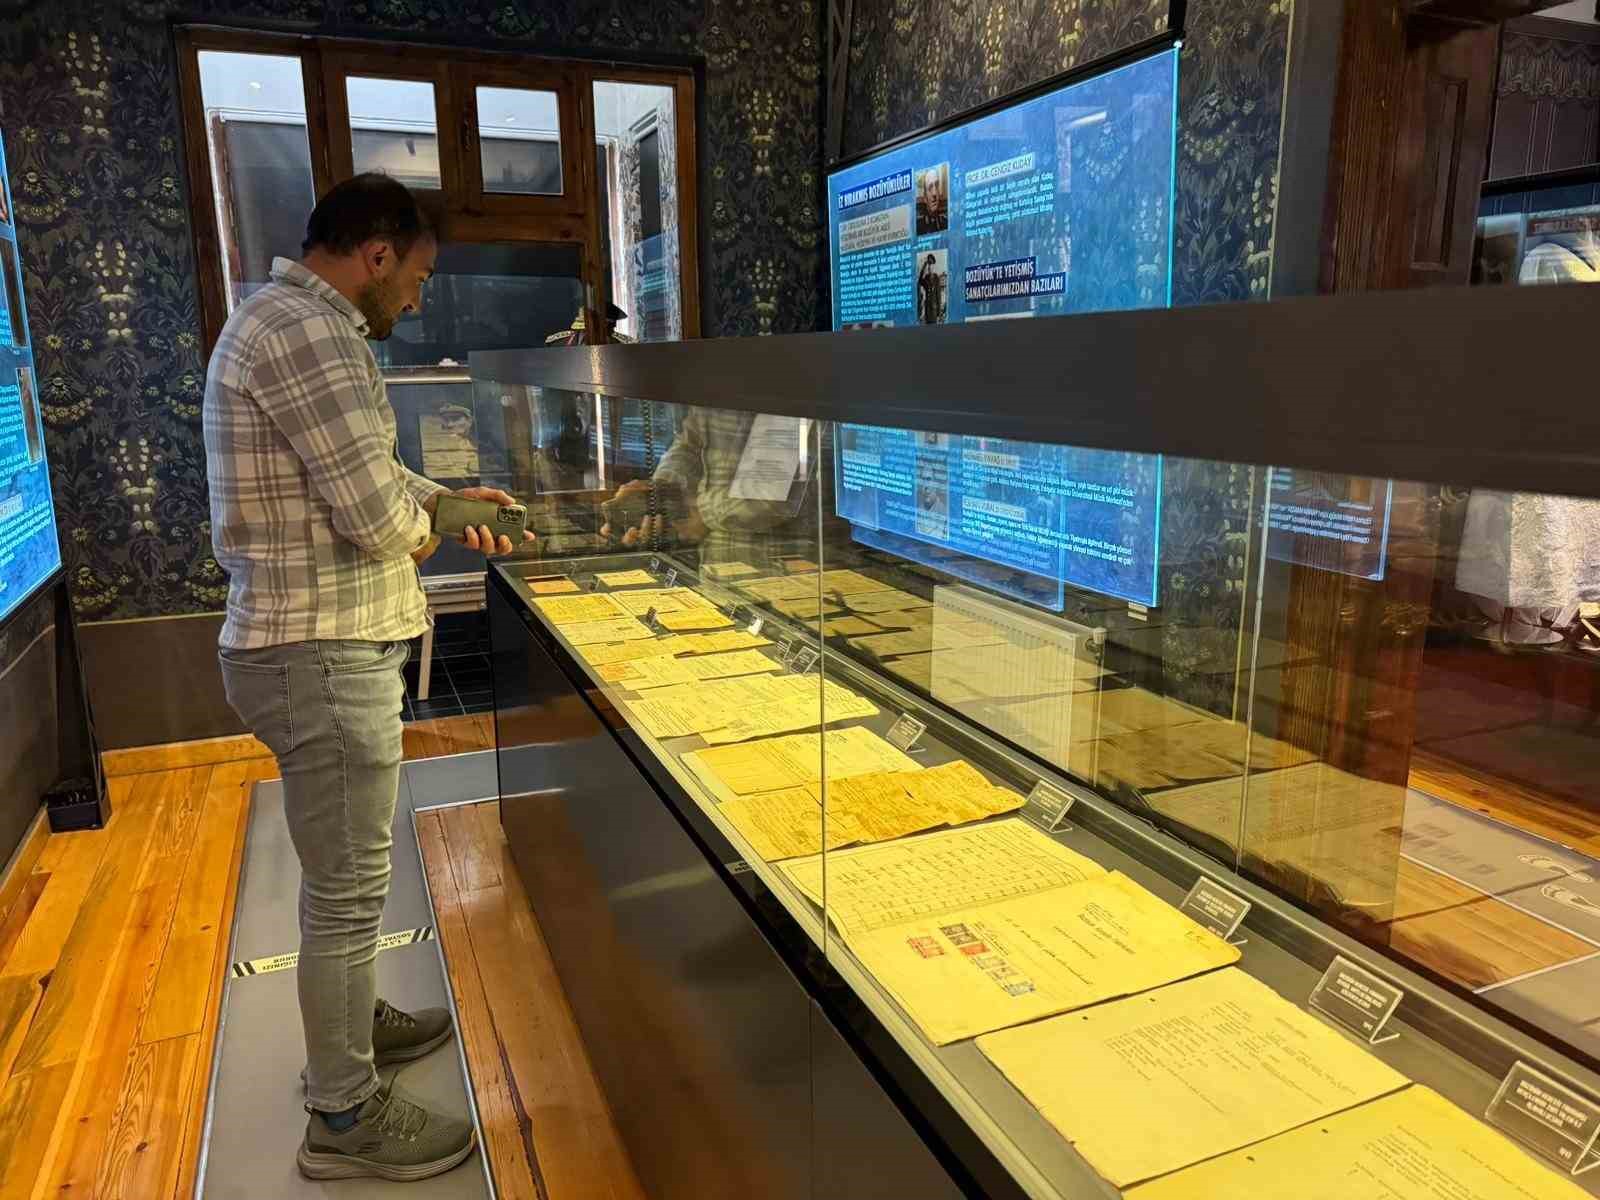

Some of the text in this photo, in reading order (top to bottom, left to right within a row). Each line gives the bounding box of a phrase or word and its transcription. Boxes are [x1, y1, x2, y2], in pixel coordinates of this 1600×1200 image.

[966, 259, 1034, 283] BOZÜYÜK'TE YETİŞMİŞ
[1031, 275, 1063, 292] BAZILARI
